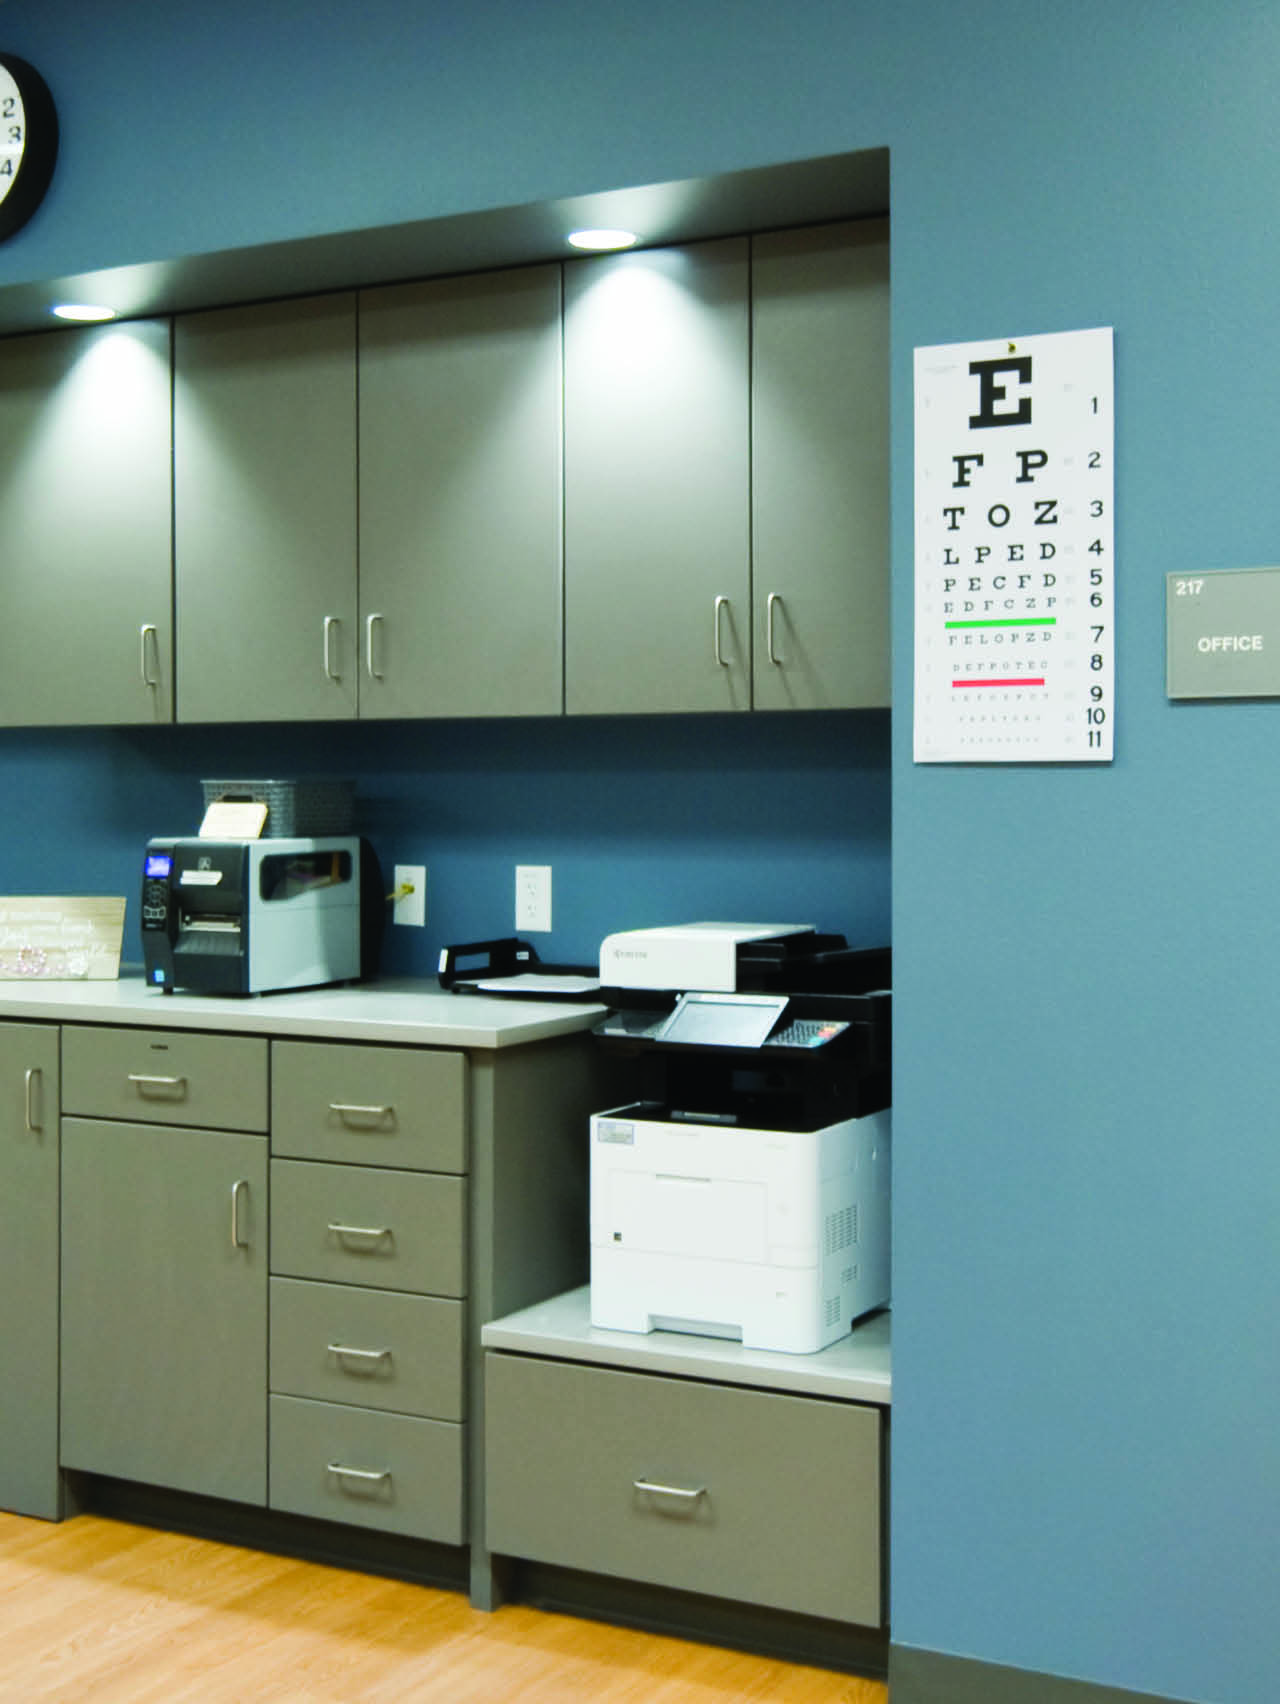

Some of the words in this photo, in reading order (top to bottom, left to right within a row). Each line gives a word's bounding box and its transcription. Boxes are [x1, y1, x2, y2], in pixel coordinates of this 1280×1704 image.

[3, 98, 15, 118] 2
[8, 125, 21, 144] 3
[0, 159, 13, 177] 4
[968, 354, 1033, 431] E
[1090, 396, 1100, 415] 1
[951, 452, 985, 489] F
[1015, 448, 1050, 484] P
[1087, 450, 1102, 470] 2
[942, 506, 966, 532] T
[987, 503, 1011, 529] O
[1033, 499, 1059, 526] Z
[1088, 499, 1105, 518] 3
[943, 547, 960, 566] L
[974, 545, 992, 564] P
[1007, 543, 1025, 562] E
[1039, 541, 1057, 561] D
[1087, 538, 1105, 557] 4
[1088, 567, 1103, 587] 5
[1176, 579, 1205, 596] 217
[1089, 591, 1104, 609] 6
[1089, 624, 1105, 644] 7
[1197, 635, 1263, 653] OFFICE
[1089, 653, 1104, 672] 8
[1089, 685, 1104, 703] 9
[1086, 707, 1106, 726] 10
[1087, 730, 1102, 748] 11
